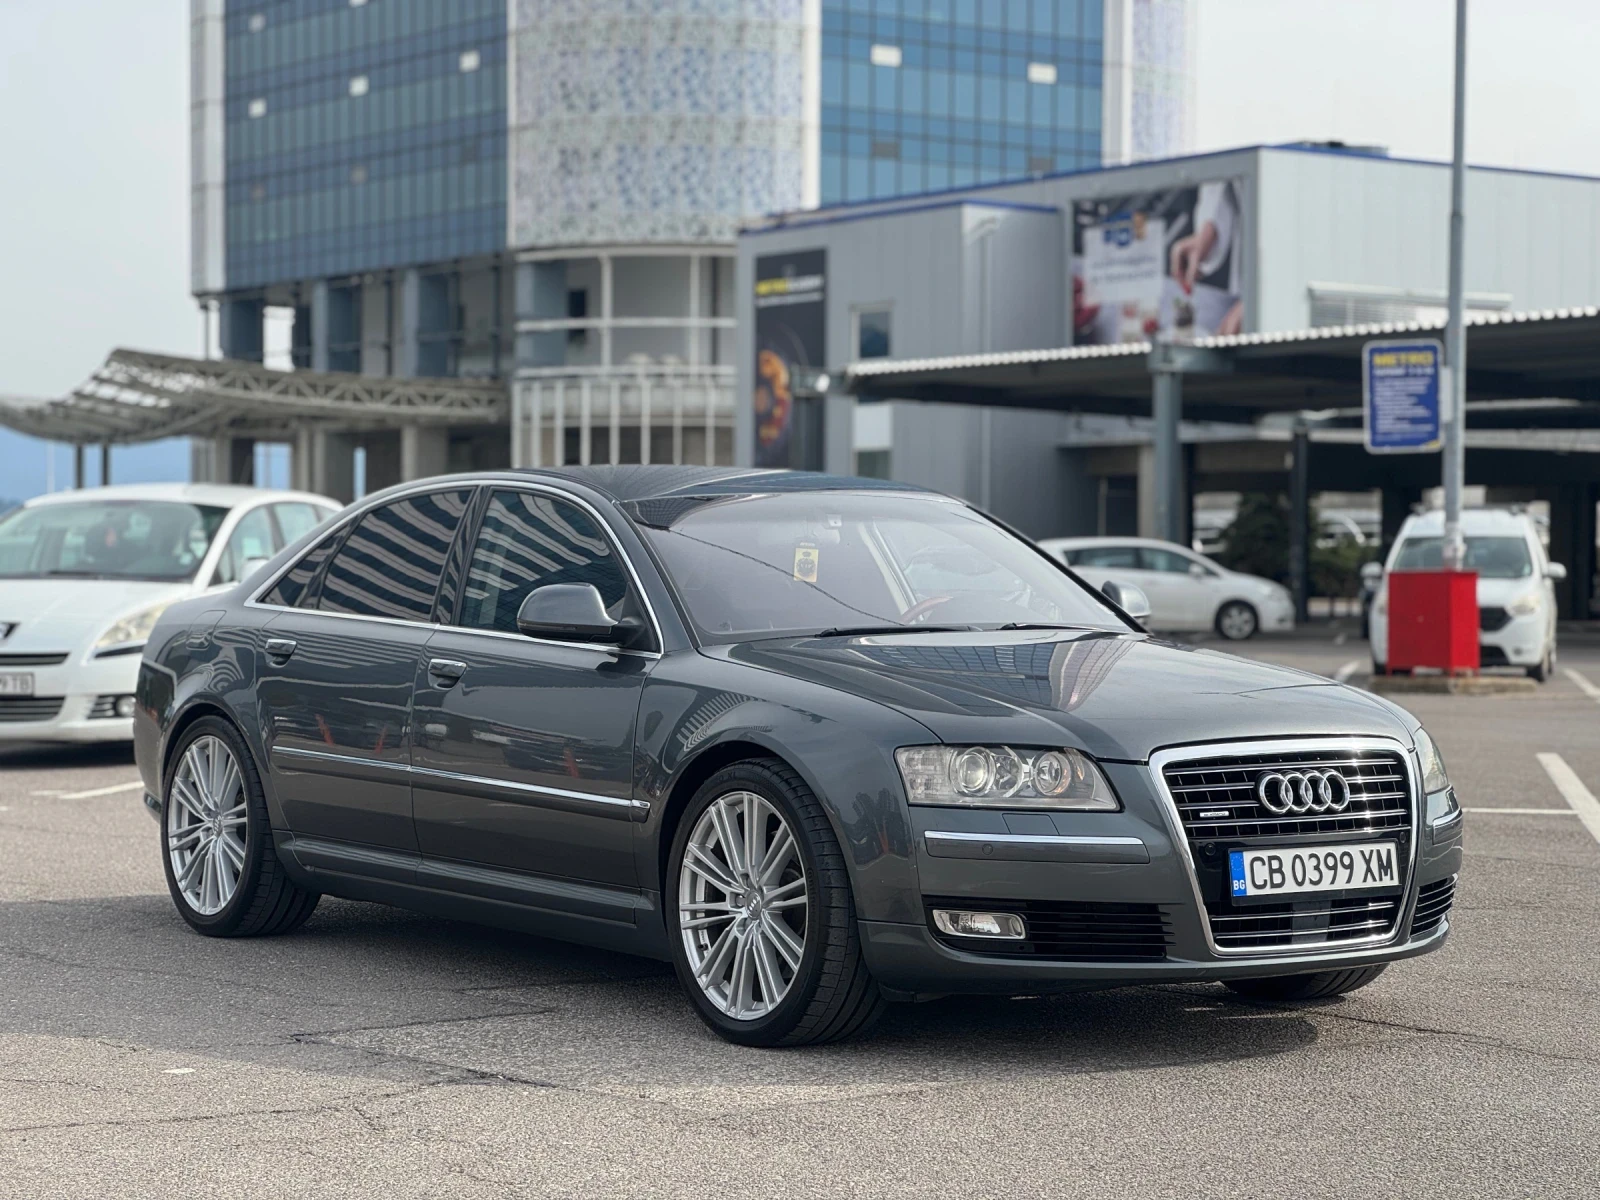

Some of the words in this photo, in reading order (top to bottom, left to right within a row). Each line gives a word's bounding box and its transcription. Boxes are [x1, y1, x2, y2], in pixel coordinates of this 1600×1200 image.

[1373, 352, 1434, 366] METRO
[1250, 854, 1287, 890] CB
[1292, 850, 1355, 887] 0399
[1359, 848, 1395, 883] XM
[1233, 880, 1246, 891] BG
